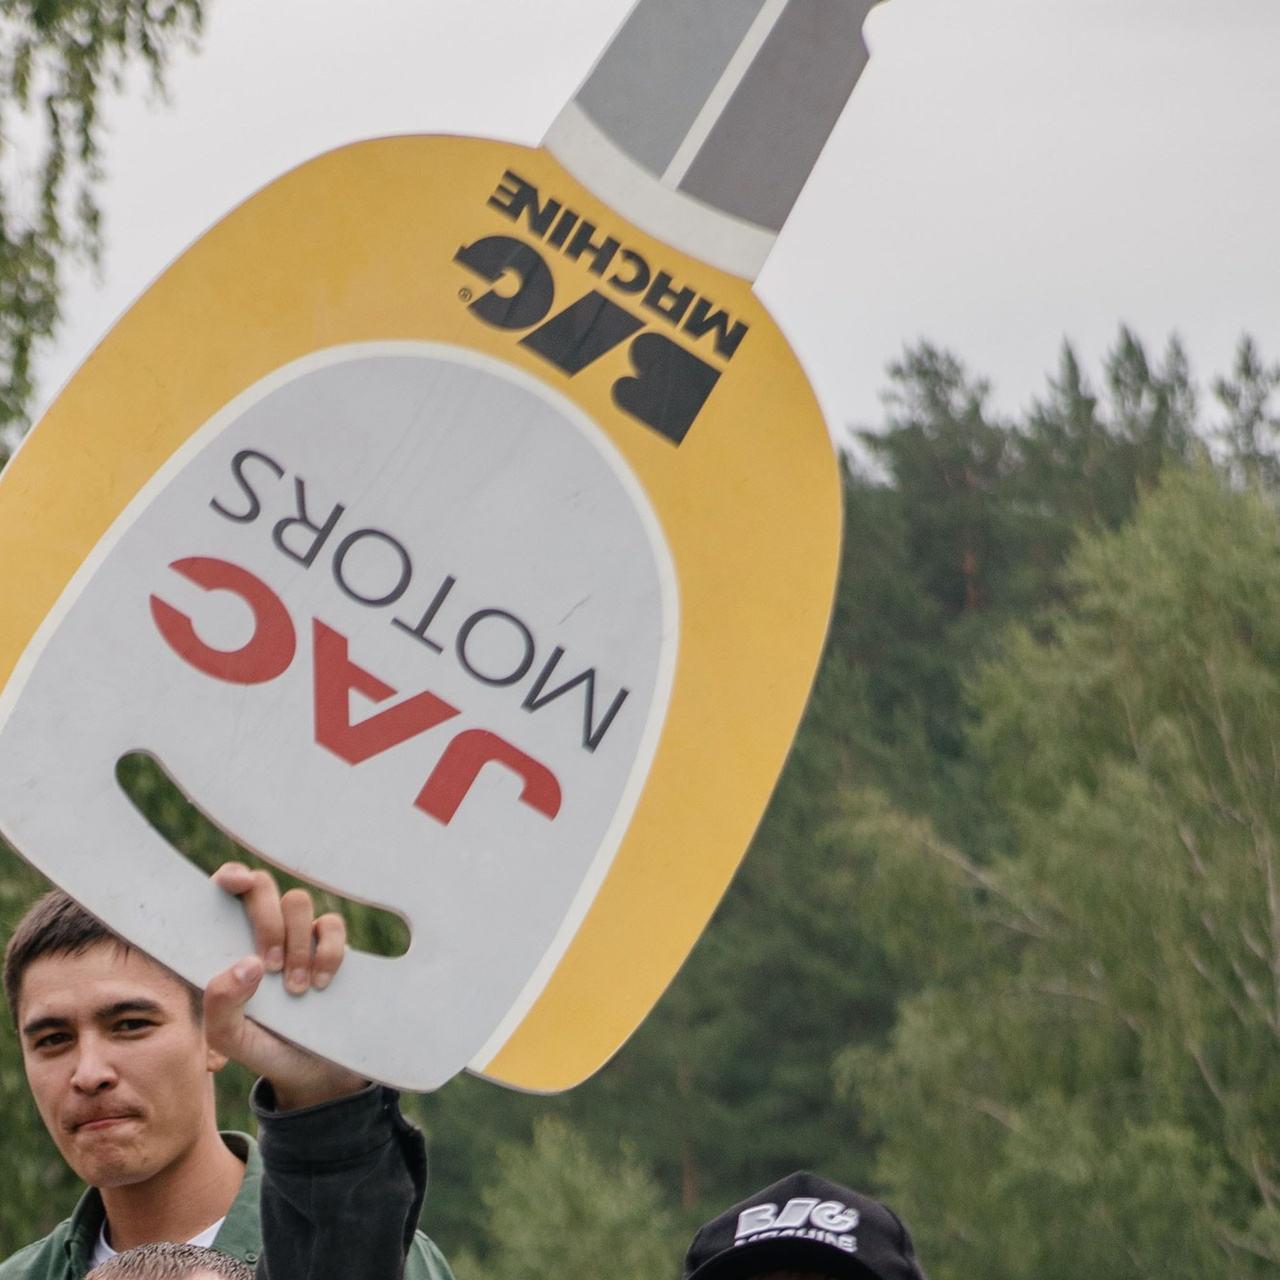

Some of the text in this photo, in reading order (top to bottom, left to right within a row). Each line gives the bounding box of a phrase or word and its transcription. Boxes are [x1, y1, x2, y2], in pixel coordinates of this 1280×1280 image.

[452, 234, 723, 448] BIG
[487, 168, 749, 362] MACHINE
[149, 556, 562, 827] JAC
[209, 448, 630, 754] MOTORS
[734, 1197, 858, 1239] BIG
